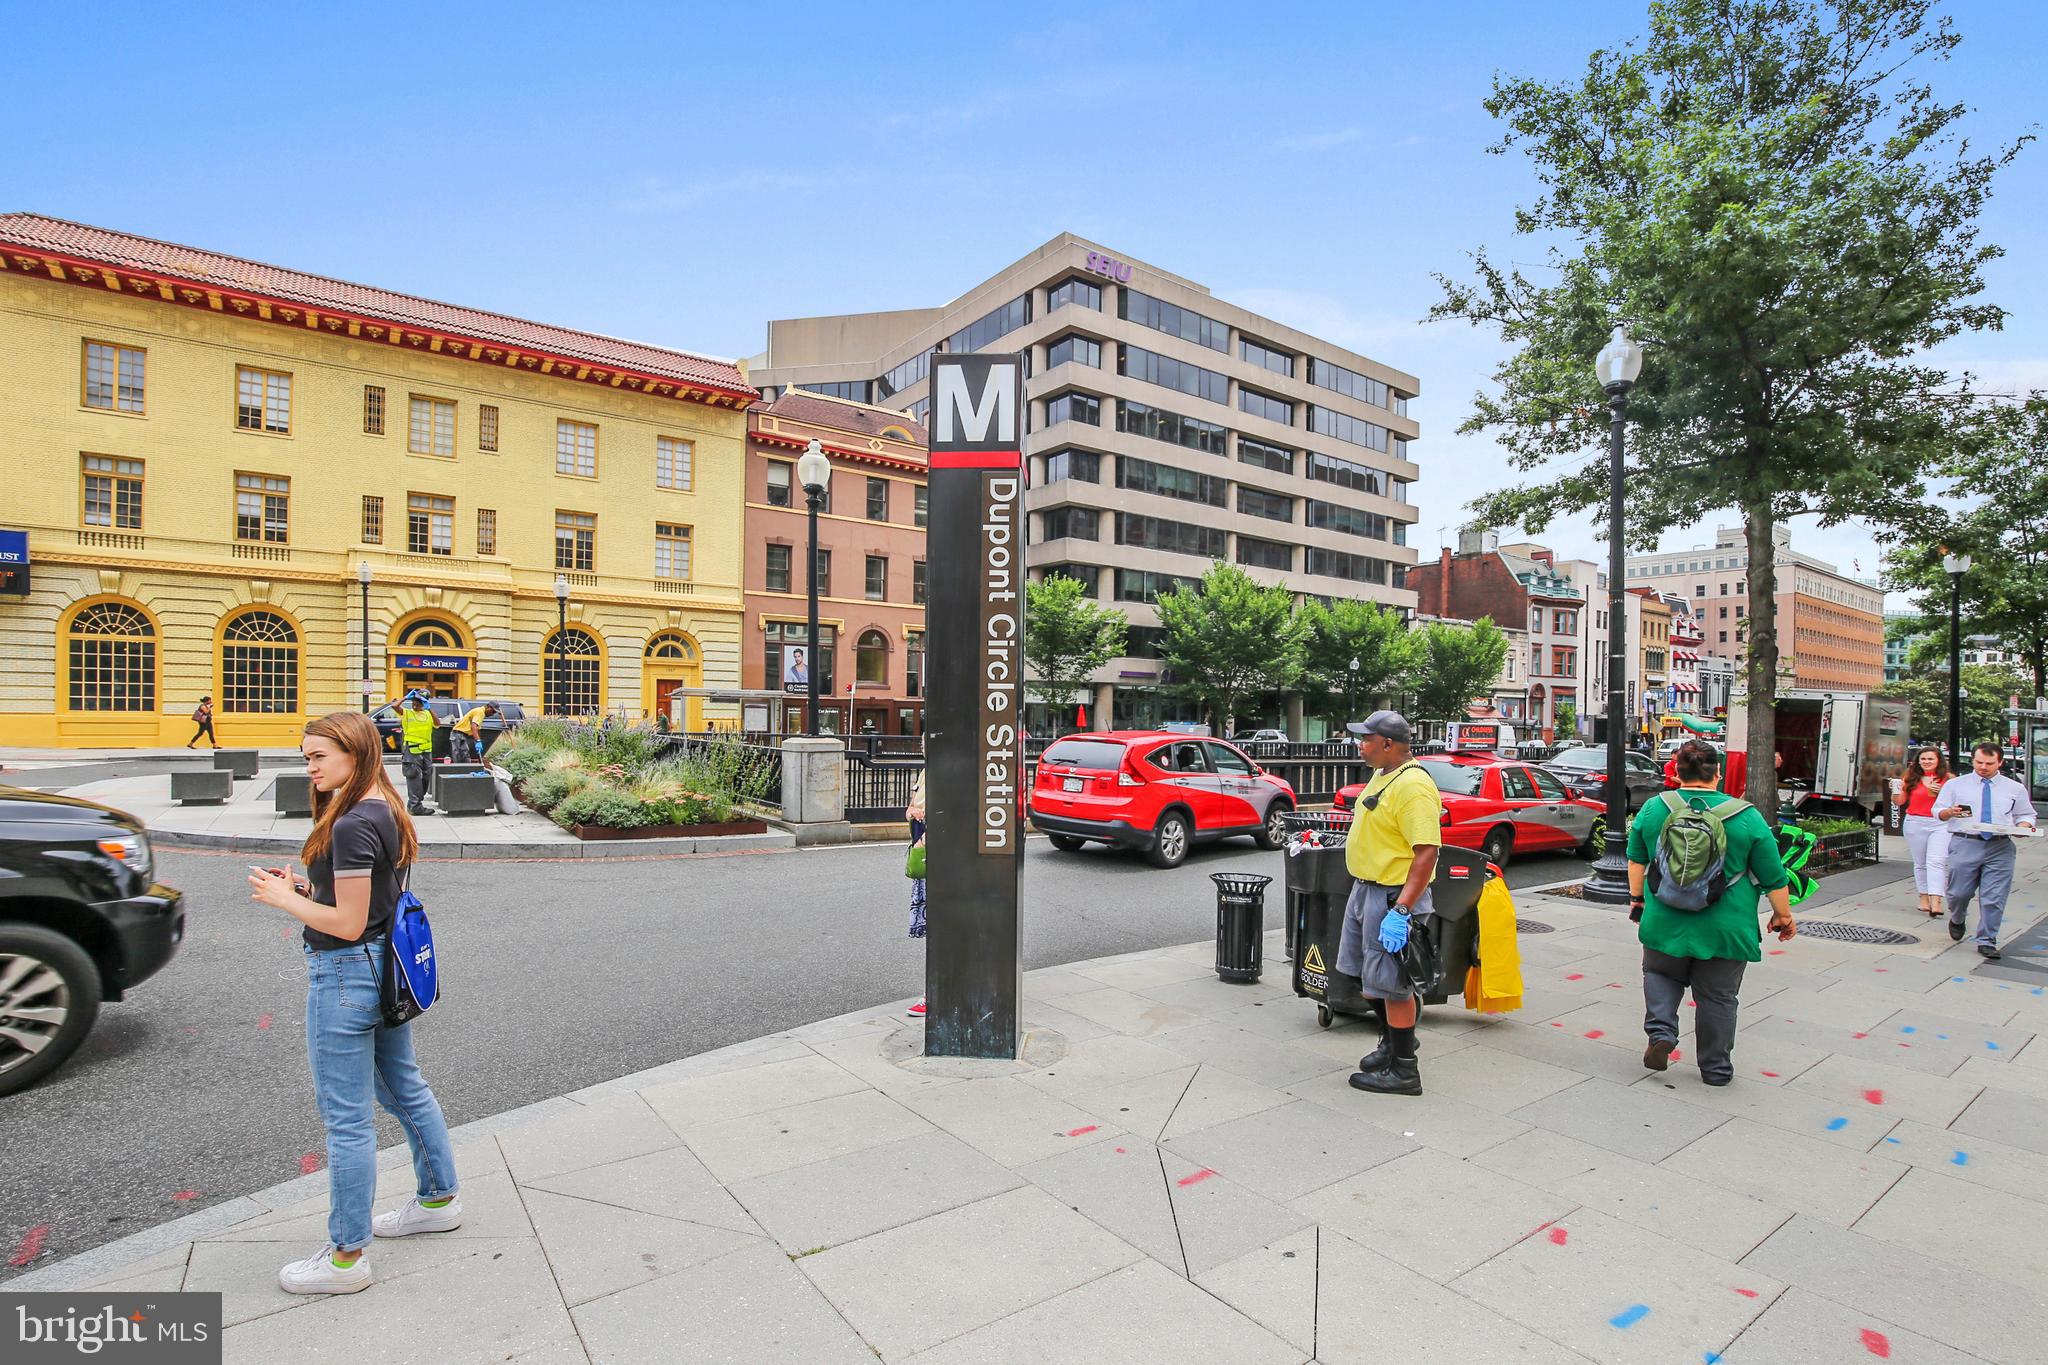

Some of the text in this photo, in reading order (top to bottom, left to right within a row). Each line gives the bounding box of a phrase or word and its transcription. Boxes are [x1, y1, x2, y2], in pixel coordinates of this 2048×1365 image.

[1087, 251, 1133, 282] SEIU
[937, 364, 1015, 442] M
[983, 478, 1017, 848] Dupont Circle Station
[1891, 800, 1900, 828] expre
[1301, 972, 1329, 989] GOLDEN
